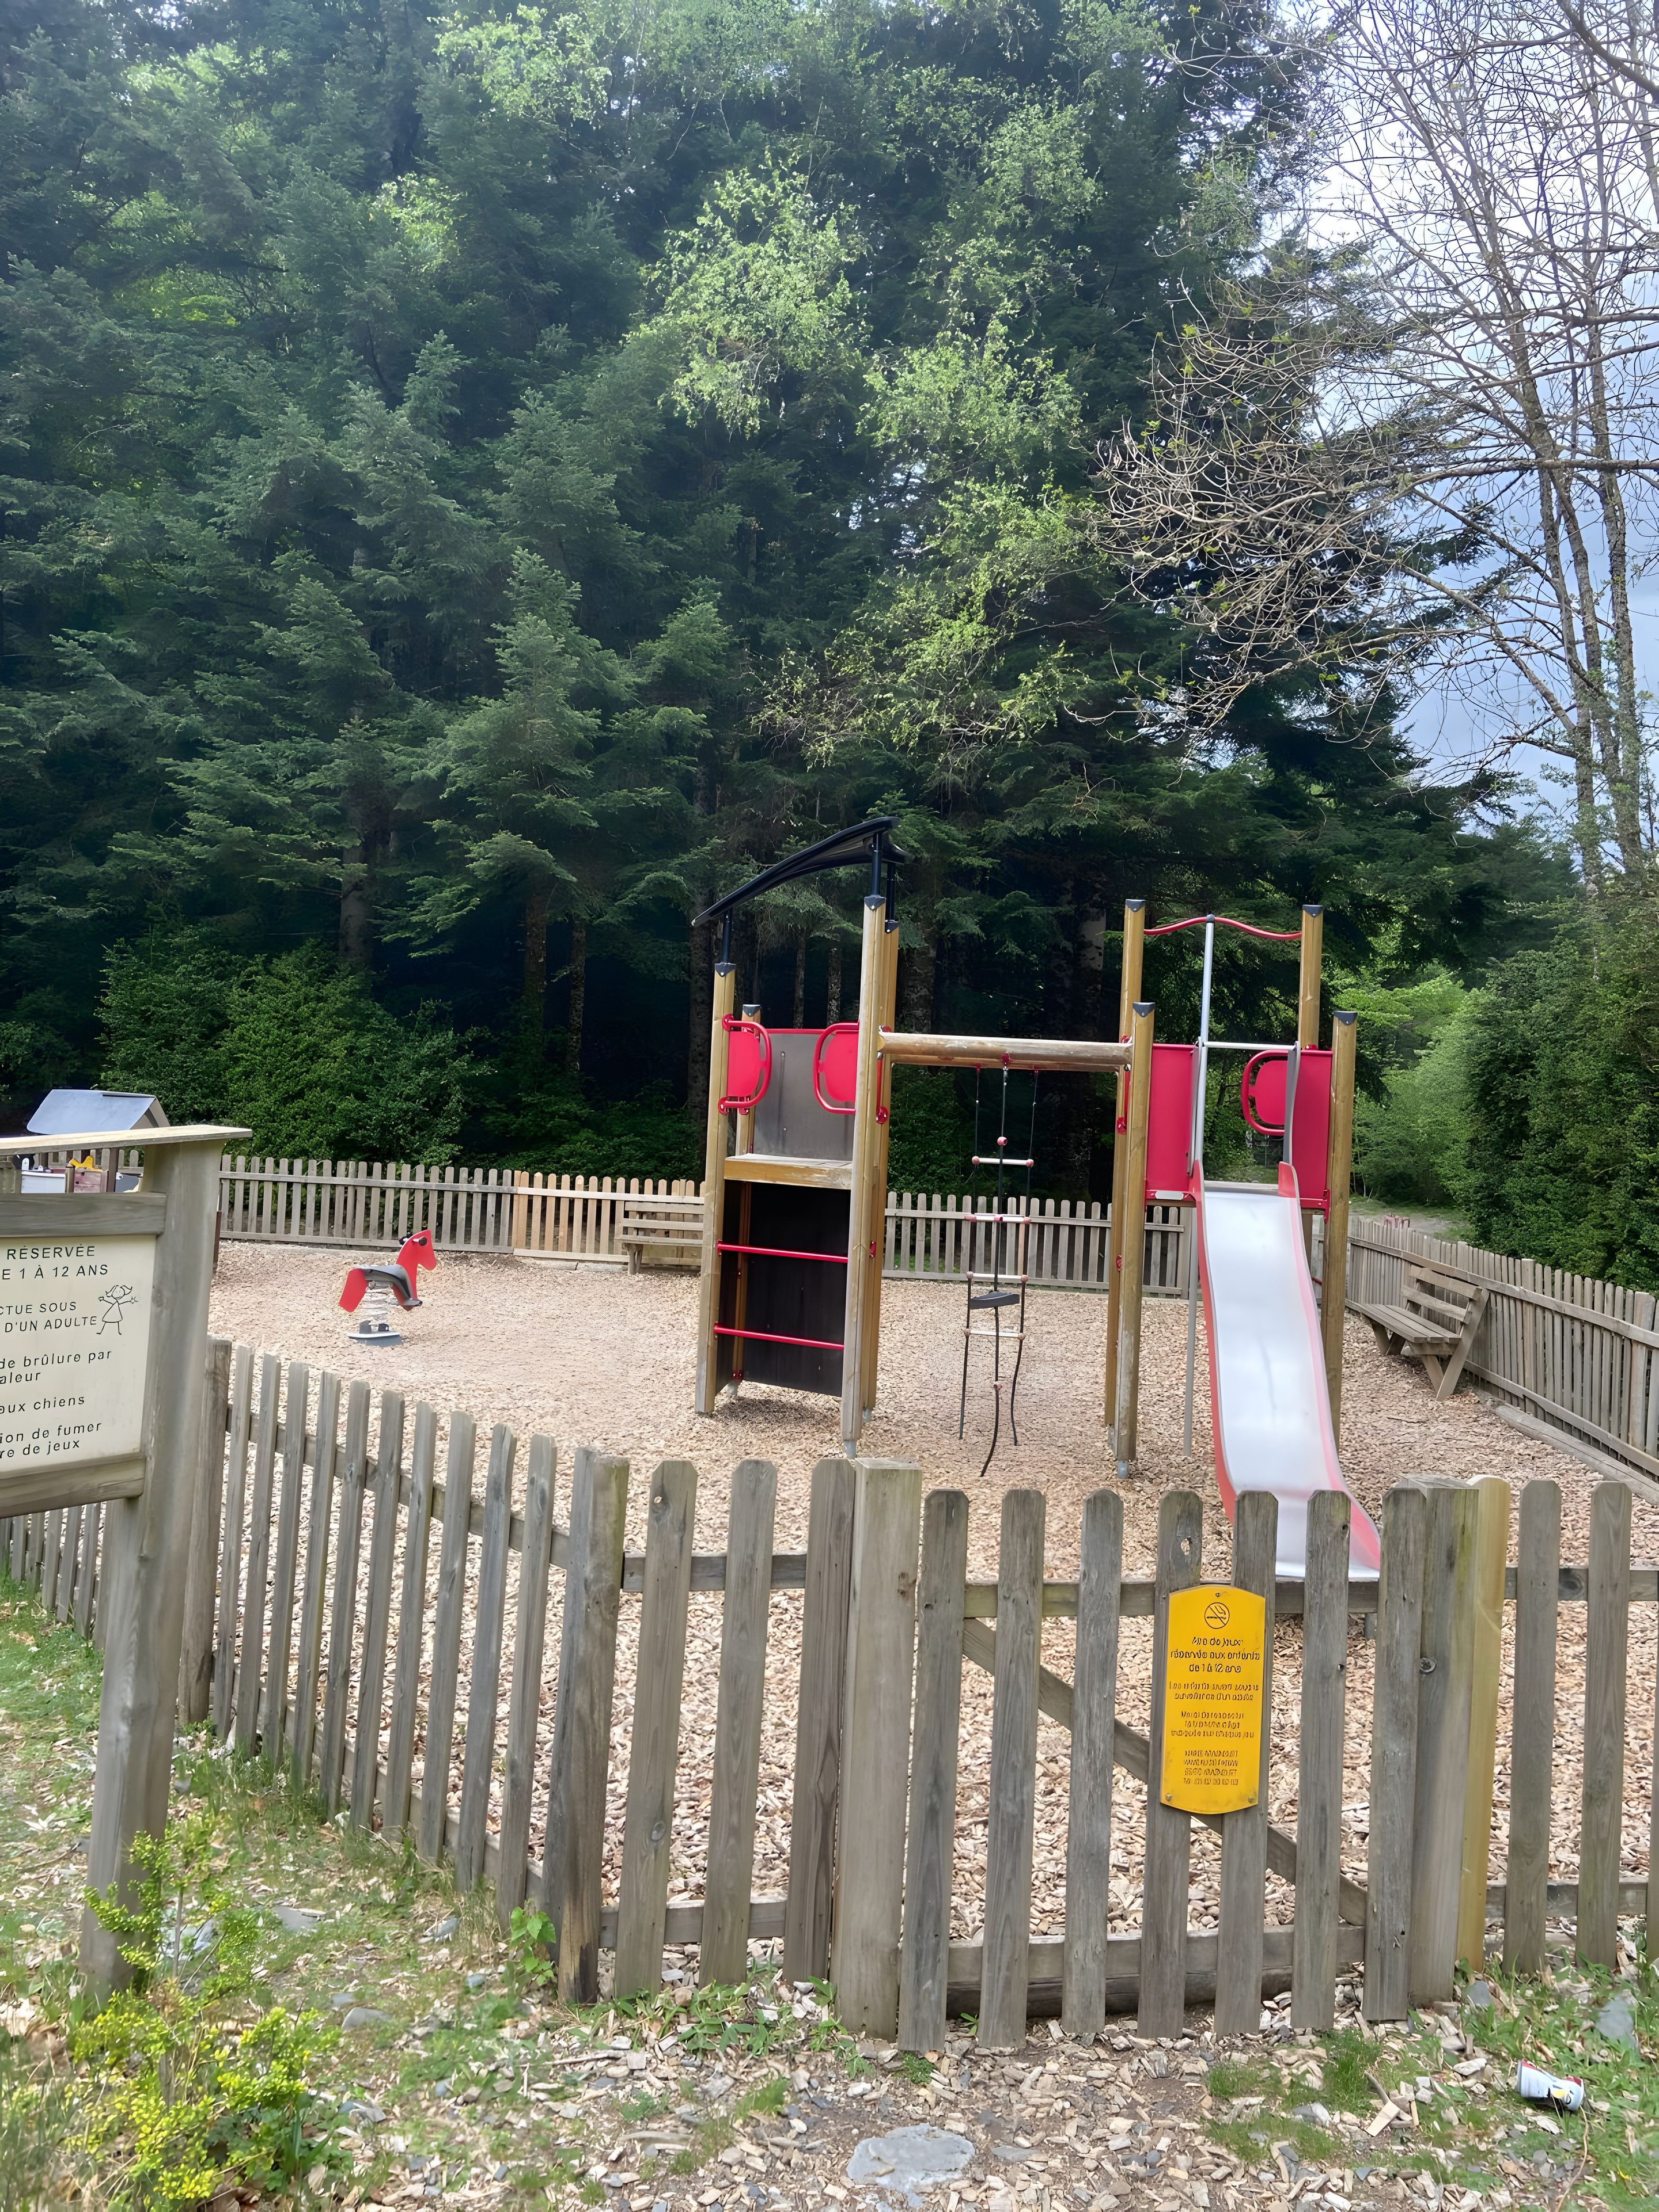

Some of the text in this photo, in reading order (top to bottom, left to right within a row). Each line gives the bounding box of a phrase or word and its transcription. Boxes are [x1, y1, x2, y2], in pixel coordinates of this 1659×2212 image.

[7, 1244, 95, 1260] RÉSERVÉE
[20, 1268, 25, 1279] 1
[34, 1264, 44, 1279] À
[52, 1266, 69, 1277] 12
[76, 1264, 108, 1277] ANS
[39, 1301, 77, 1313] SOUS
[5, 1316, 97, 1333] D'UN ADULTE
[88, 1351, 112, 1364] par
[33, 1396, 85, 1410] chiens
[32, 1428, 50, 1440] de
[58, 1423, 102, 1437] fumer
[22, 1444, 40, 1456] de
[47, 1440, 79, 1456] jeux
